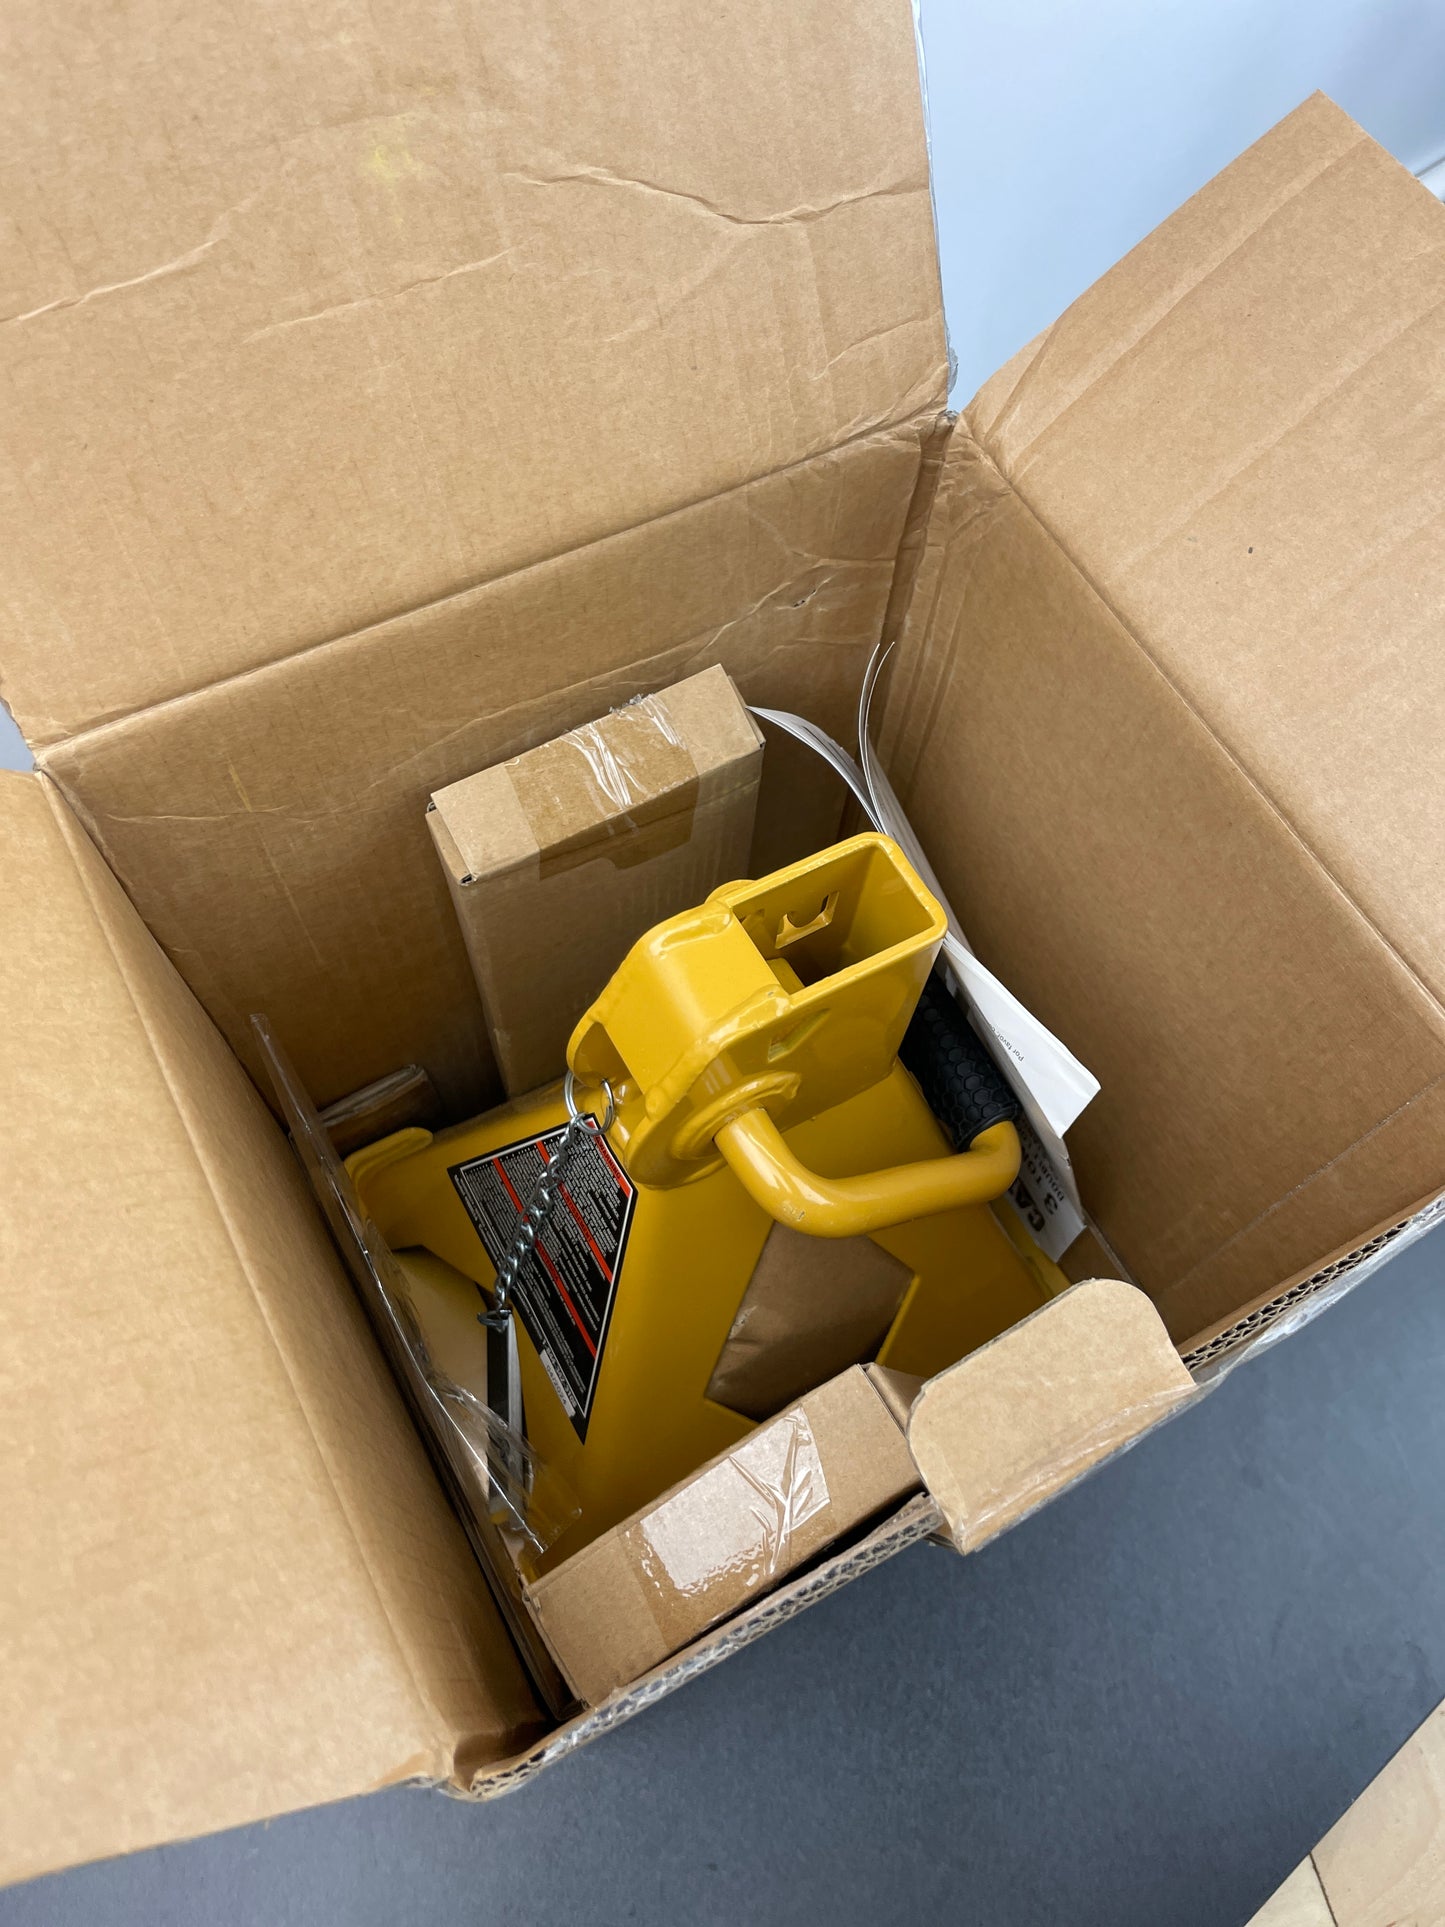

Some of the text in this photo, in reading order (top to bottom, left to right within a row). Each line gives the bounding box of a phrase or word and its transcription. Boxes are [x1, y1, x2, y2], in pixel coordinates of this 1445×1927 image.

[1013, 1049, 1025, 1062] Por
[599, 1144, 622, 1179] WARNING
[1044, 1193, 1058, 1216] 3
